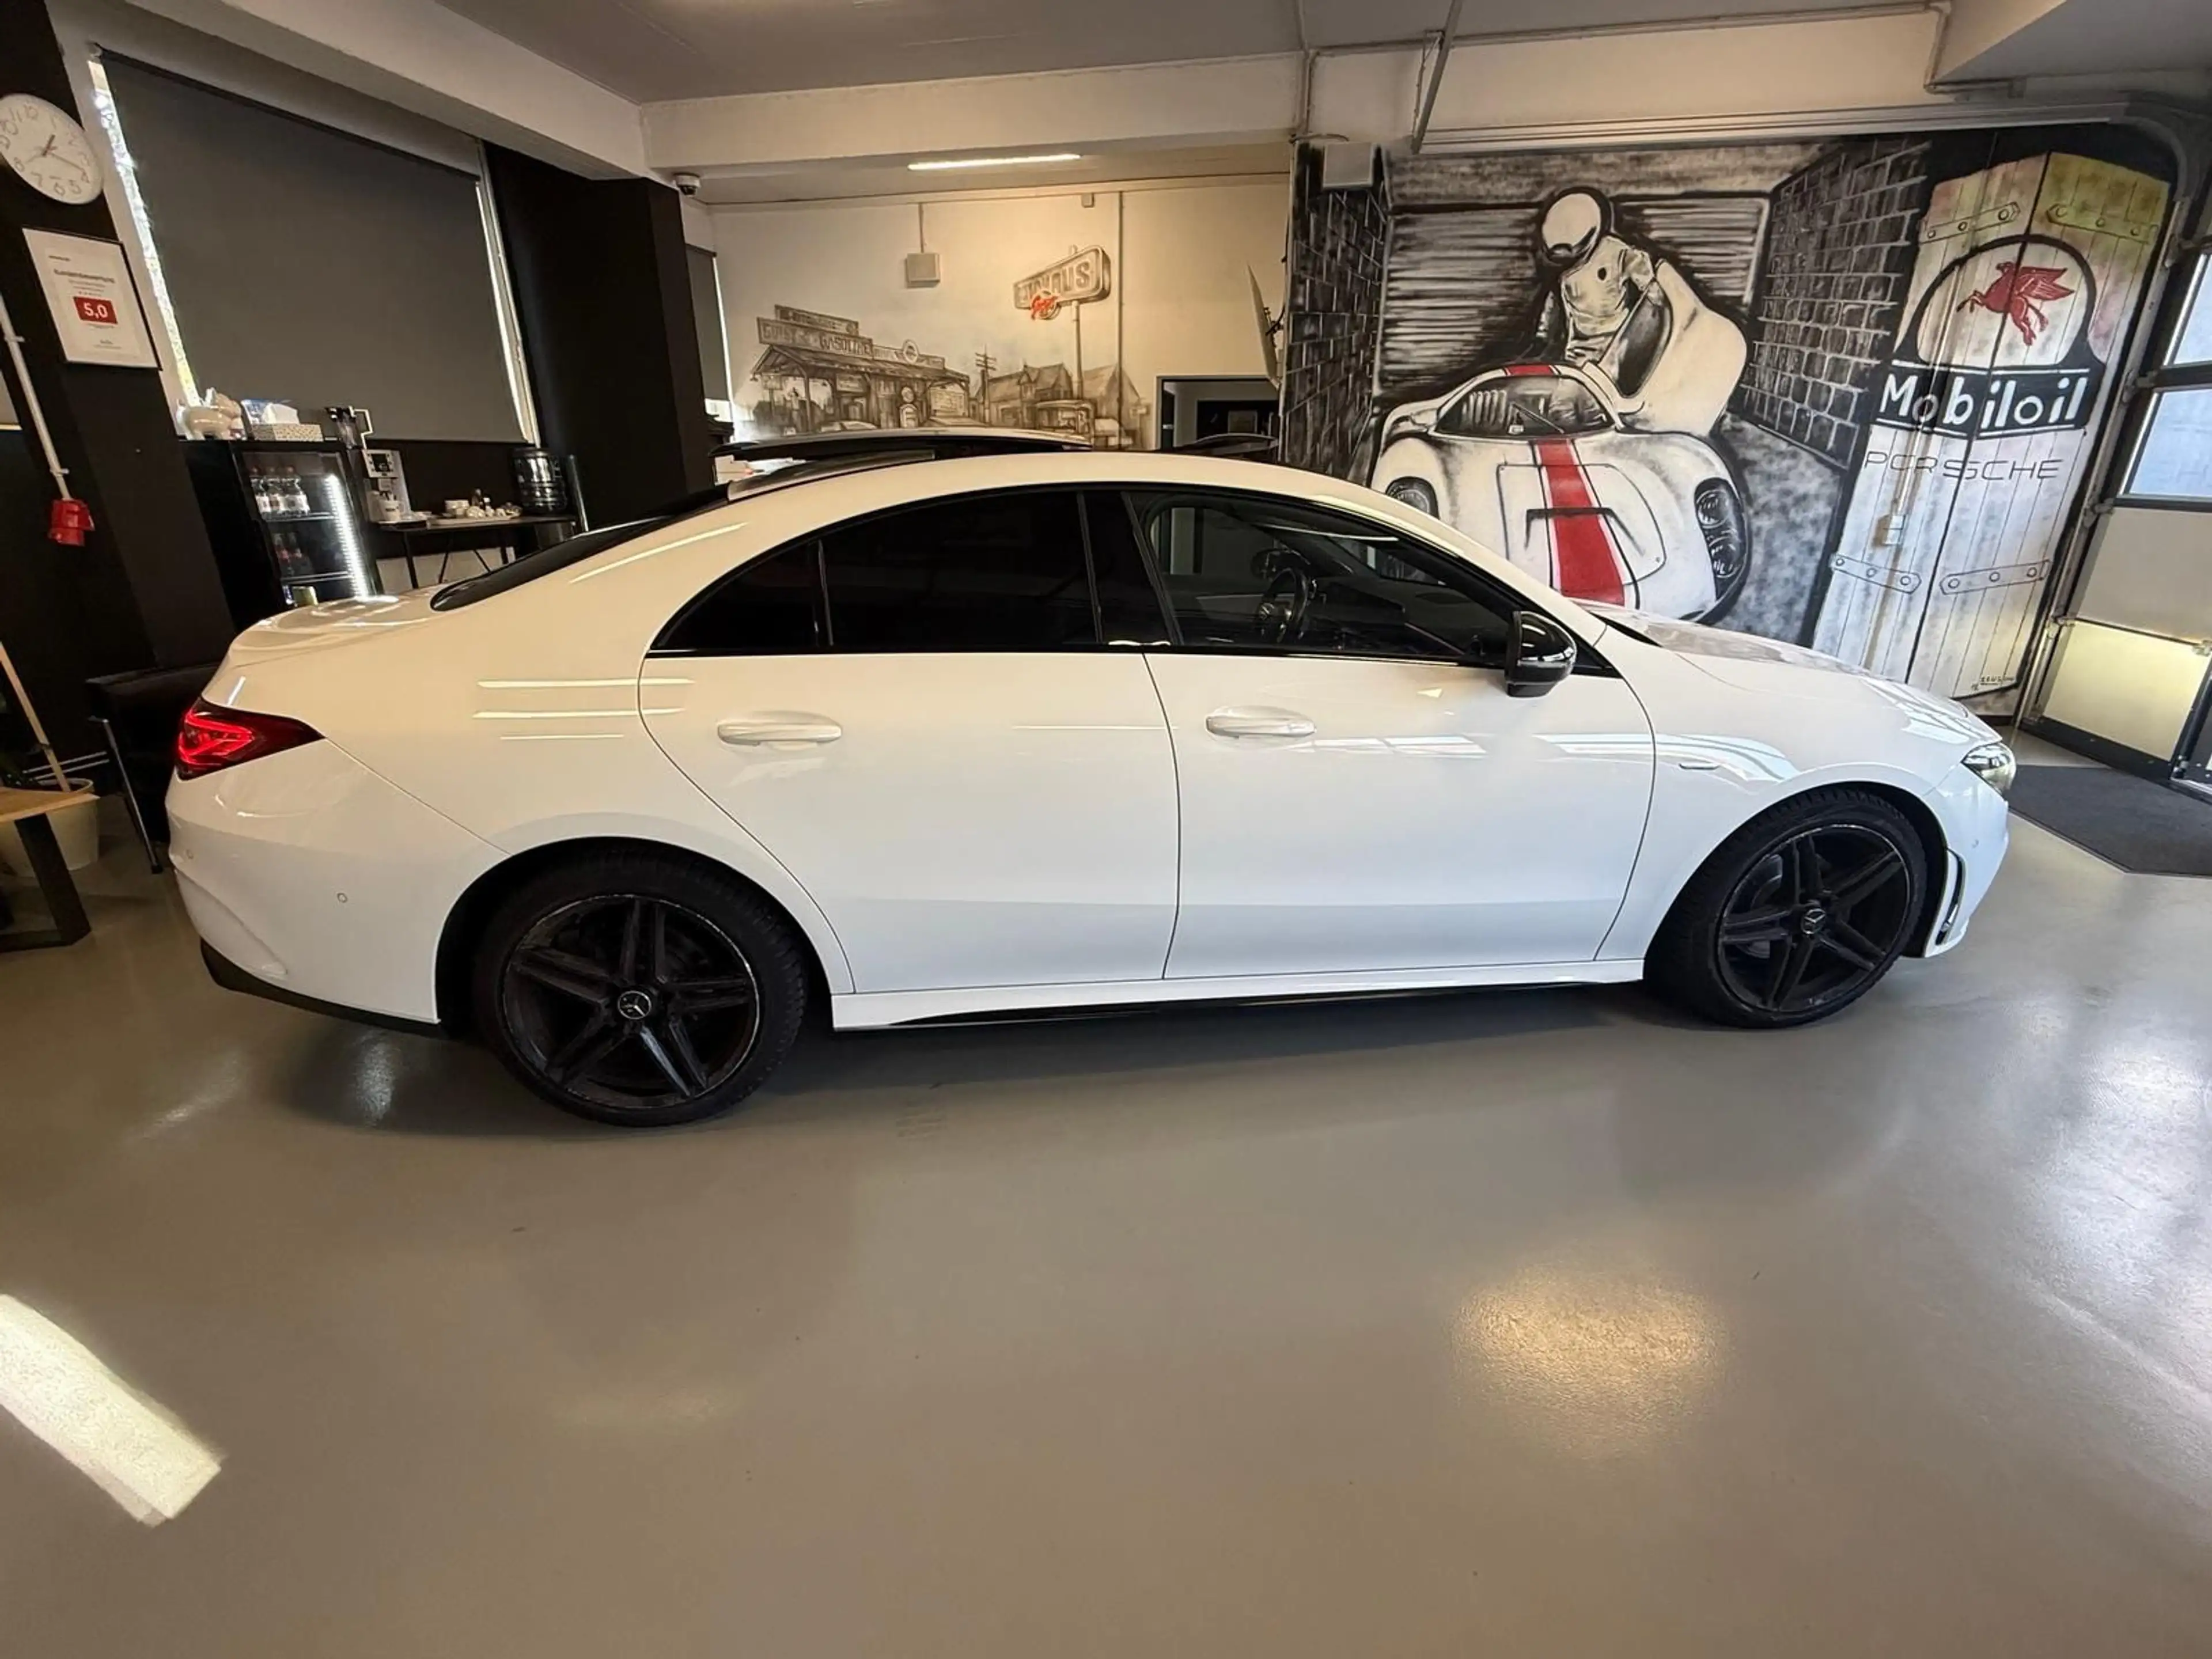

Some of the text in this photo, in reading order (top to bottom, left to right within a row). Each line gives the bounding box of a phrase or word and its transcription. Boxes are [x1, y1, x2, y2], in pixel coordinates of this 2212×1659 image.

[84, 302, 109, 319] 5,0
[1879, 373, 2089, 429] Mobiloil
[1864, 450, 2064, 480] PORSCHE
